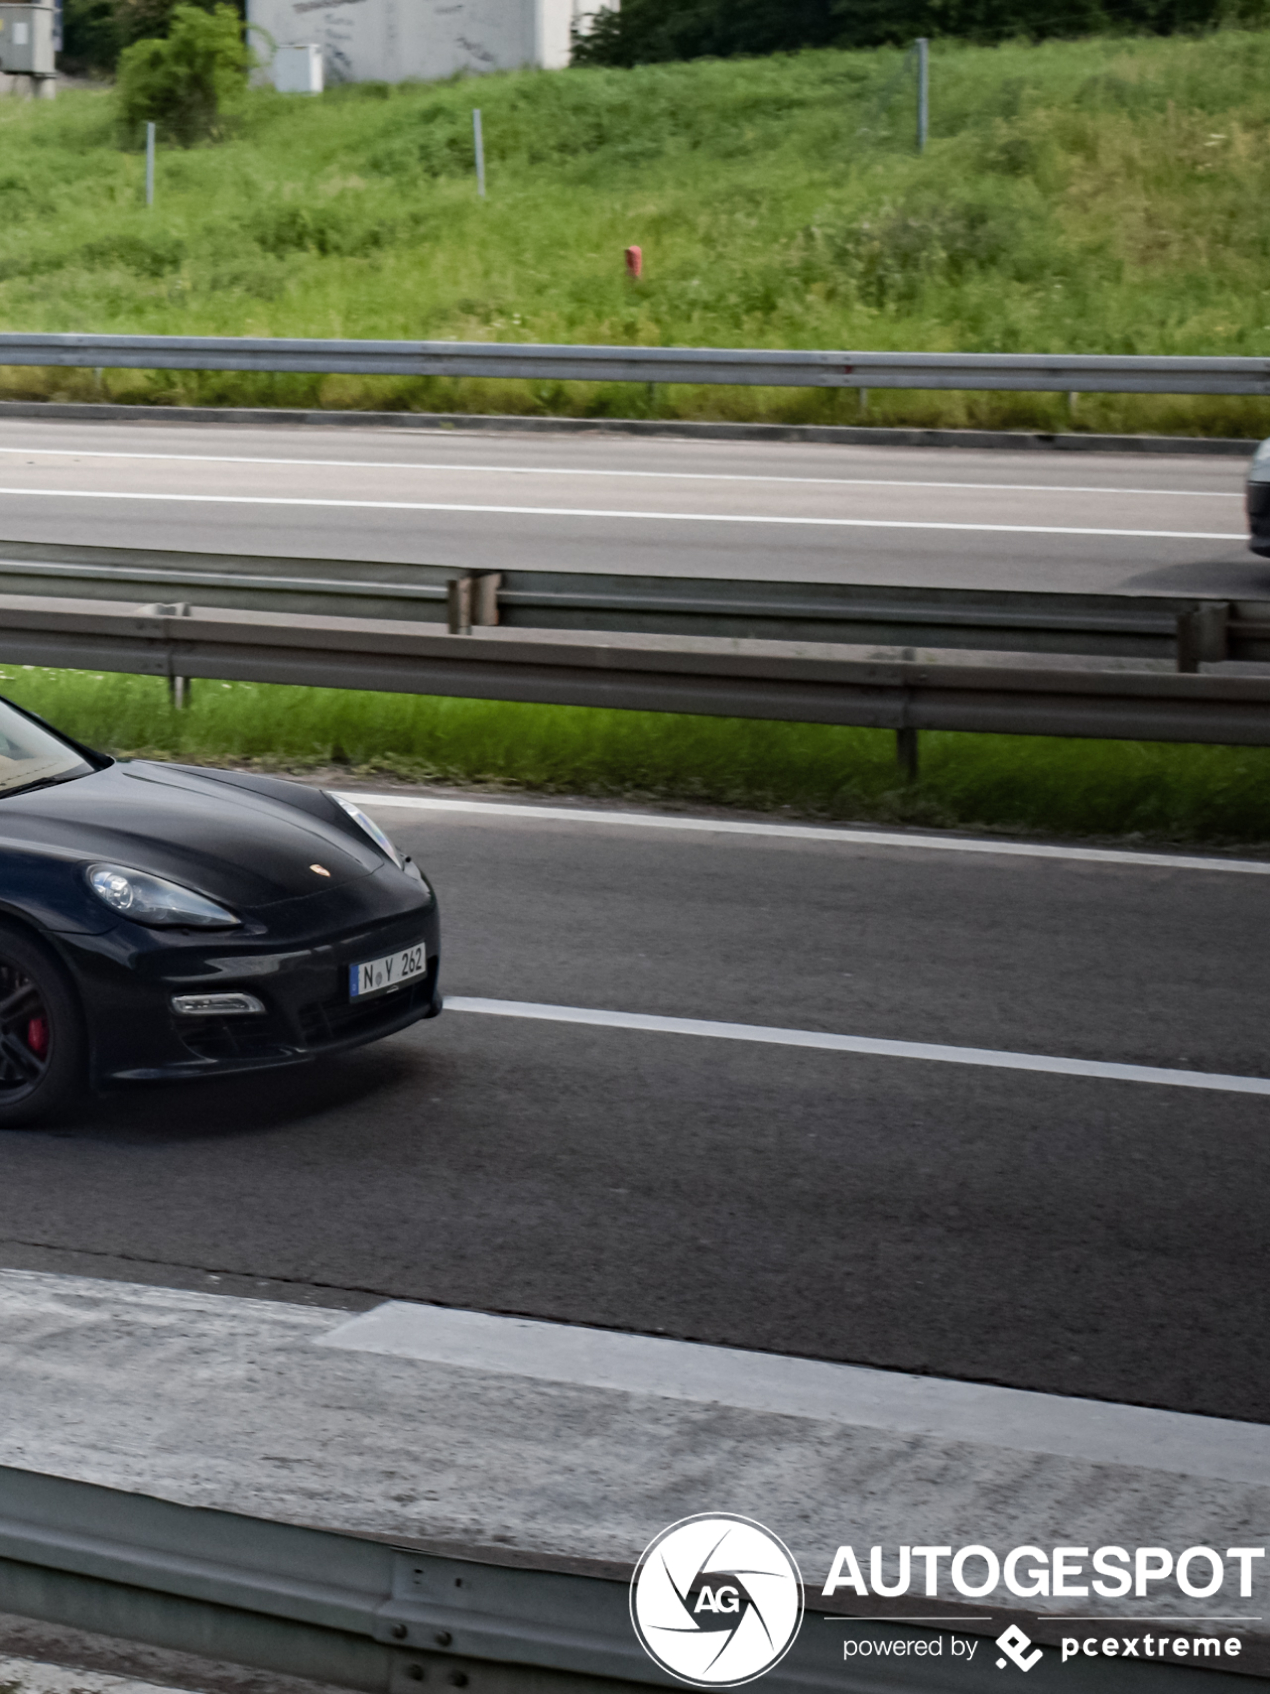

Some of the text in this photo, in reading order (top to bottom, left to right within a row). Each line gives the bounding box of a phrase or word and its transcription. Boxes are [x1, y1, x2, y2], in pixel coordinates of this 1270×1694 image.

[364, 947, 422, 989] N Y 262
